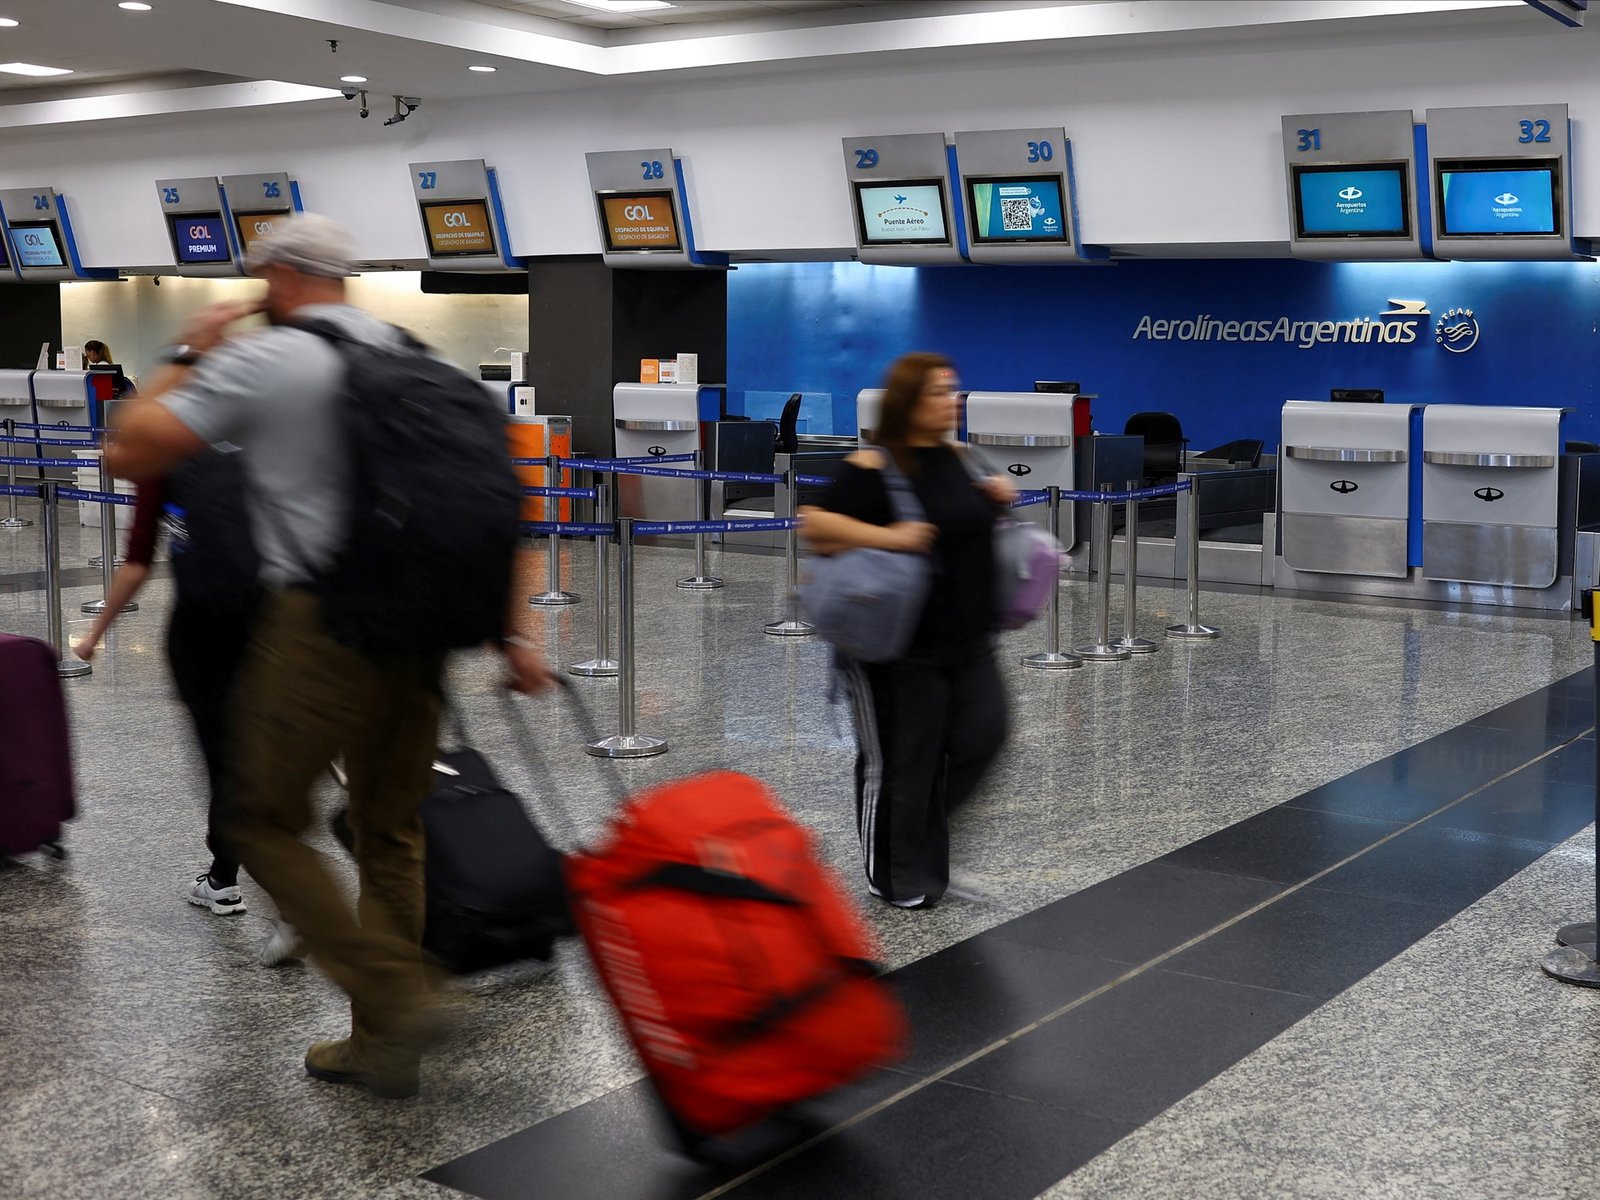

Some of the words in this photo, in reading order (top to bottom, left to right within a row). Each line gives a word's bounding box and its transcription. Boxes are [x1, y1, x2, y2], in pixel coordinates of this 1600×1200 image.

[1518, 119, 1551, 143] 32
[1297, 129, 1321, 151] 31
[854, 148, 879, 169] 29
[1026, 140, 1053, 163] 30
[641, 160, 664, 180] 28
[418, 172, 437, 189] 27
[162, 187, 180, 204] 25
[262, 181, 281, 198] 26
[33, 195, 50, 210] 24
[444, 212, 471, 227] GOL
[624, 205, 654, 221] GOL
[24, 233, 44, 246] GOL
[190, 225, 212, 239] GOL
[188, 244, 217, 253] PREMIUM
